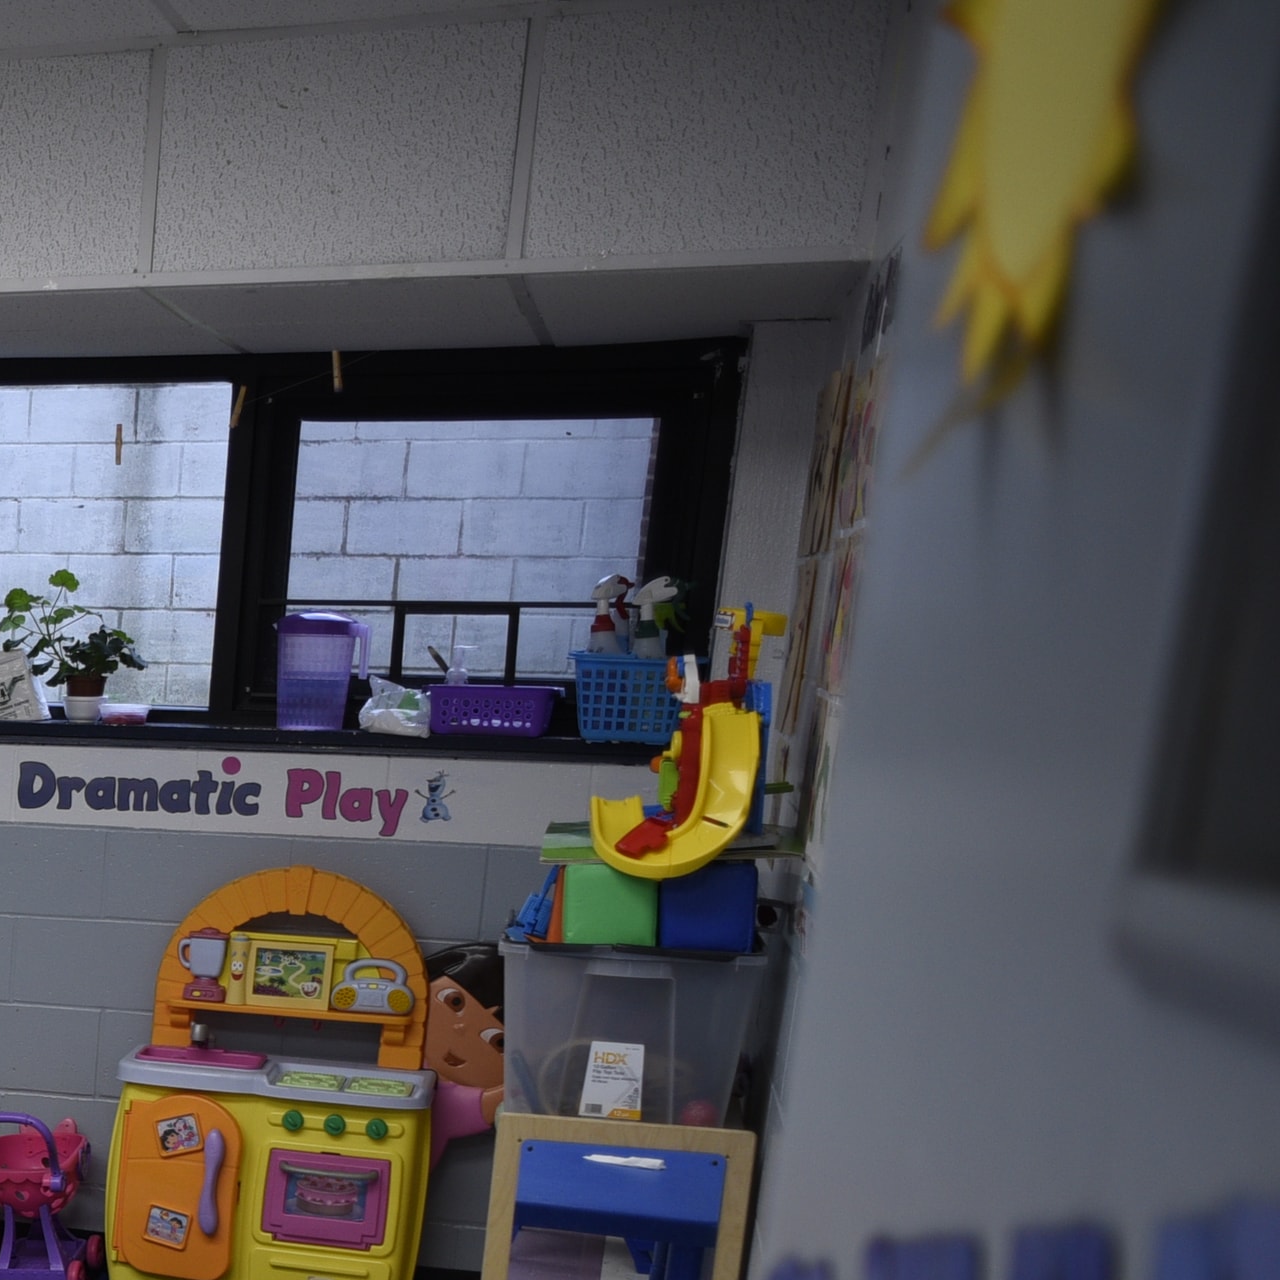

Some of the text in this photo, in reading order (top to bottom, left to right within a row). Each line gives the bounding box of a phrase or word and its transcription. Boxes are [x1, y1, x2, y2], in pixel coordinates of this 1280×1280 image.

[16, 756, 409, 836] Dramatic Play
[593, 1050, 628, 1066] HDX
